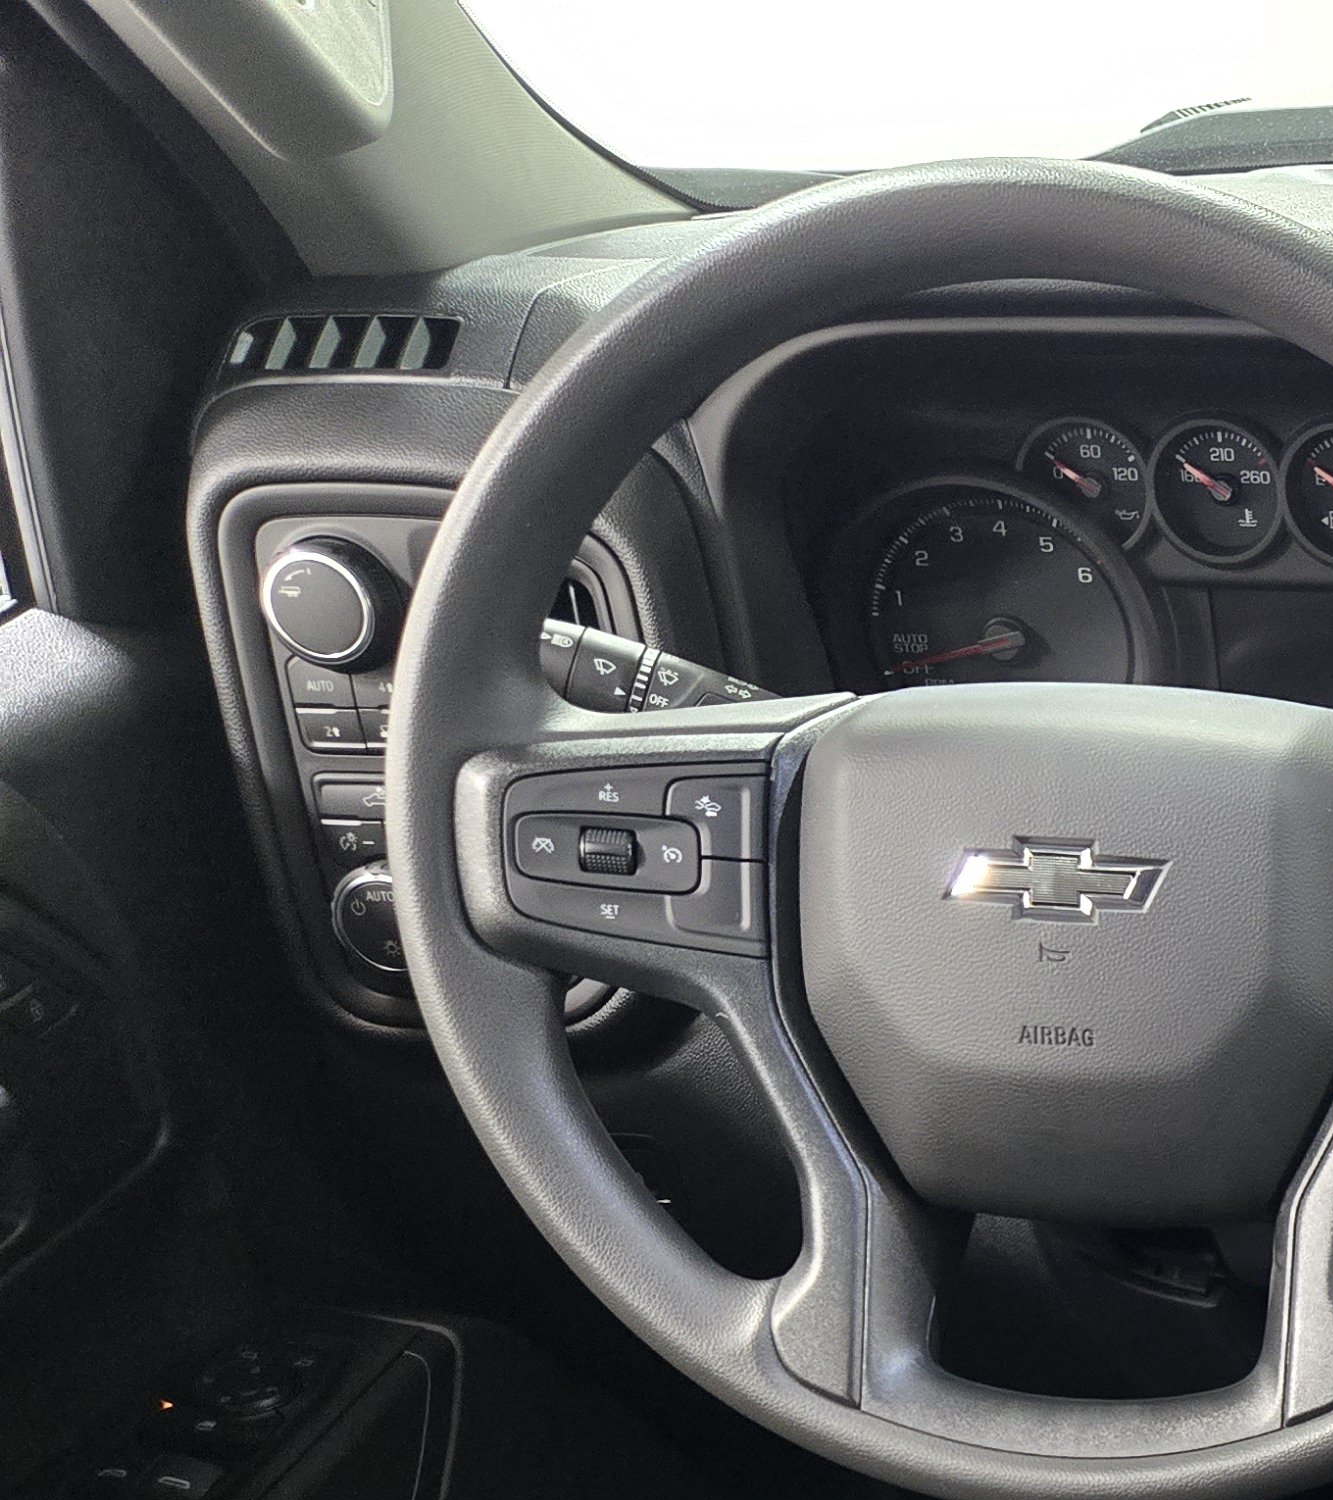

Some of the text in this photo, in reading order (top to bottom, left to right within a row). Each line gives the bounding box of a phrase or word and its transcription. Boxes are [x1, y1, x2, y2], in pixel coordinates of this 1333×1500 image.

[1080, 445, 1101, 458] 60
[1210, 447, 1235, 462] 210
[1112, 467, 1138, 481] 120
[1240, 470, 1270, 485] 260
[949, 525, 964, 543] 3
[992, 520, 1007, 537] 4
[1039, 536, 1054, 552] 5
[914, 550, 929, 567] 2
[1077, 567, 1093, 583] 6
[895, 590, 903, 606] 1
[892, 633, 928, 644] AUTO
[894, 643, 928, 653] STOP
[306, 680, 334, 692] AUTO
[649, 693, 669, 708] OFF
[599, 791, 620, 802] RES
[366, 890, 396, 902] AUTO
[600, 904, 620, 915] SET
[1018, 1024, 1095, 1047] AIRBAG
